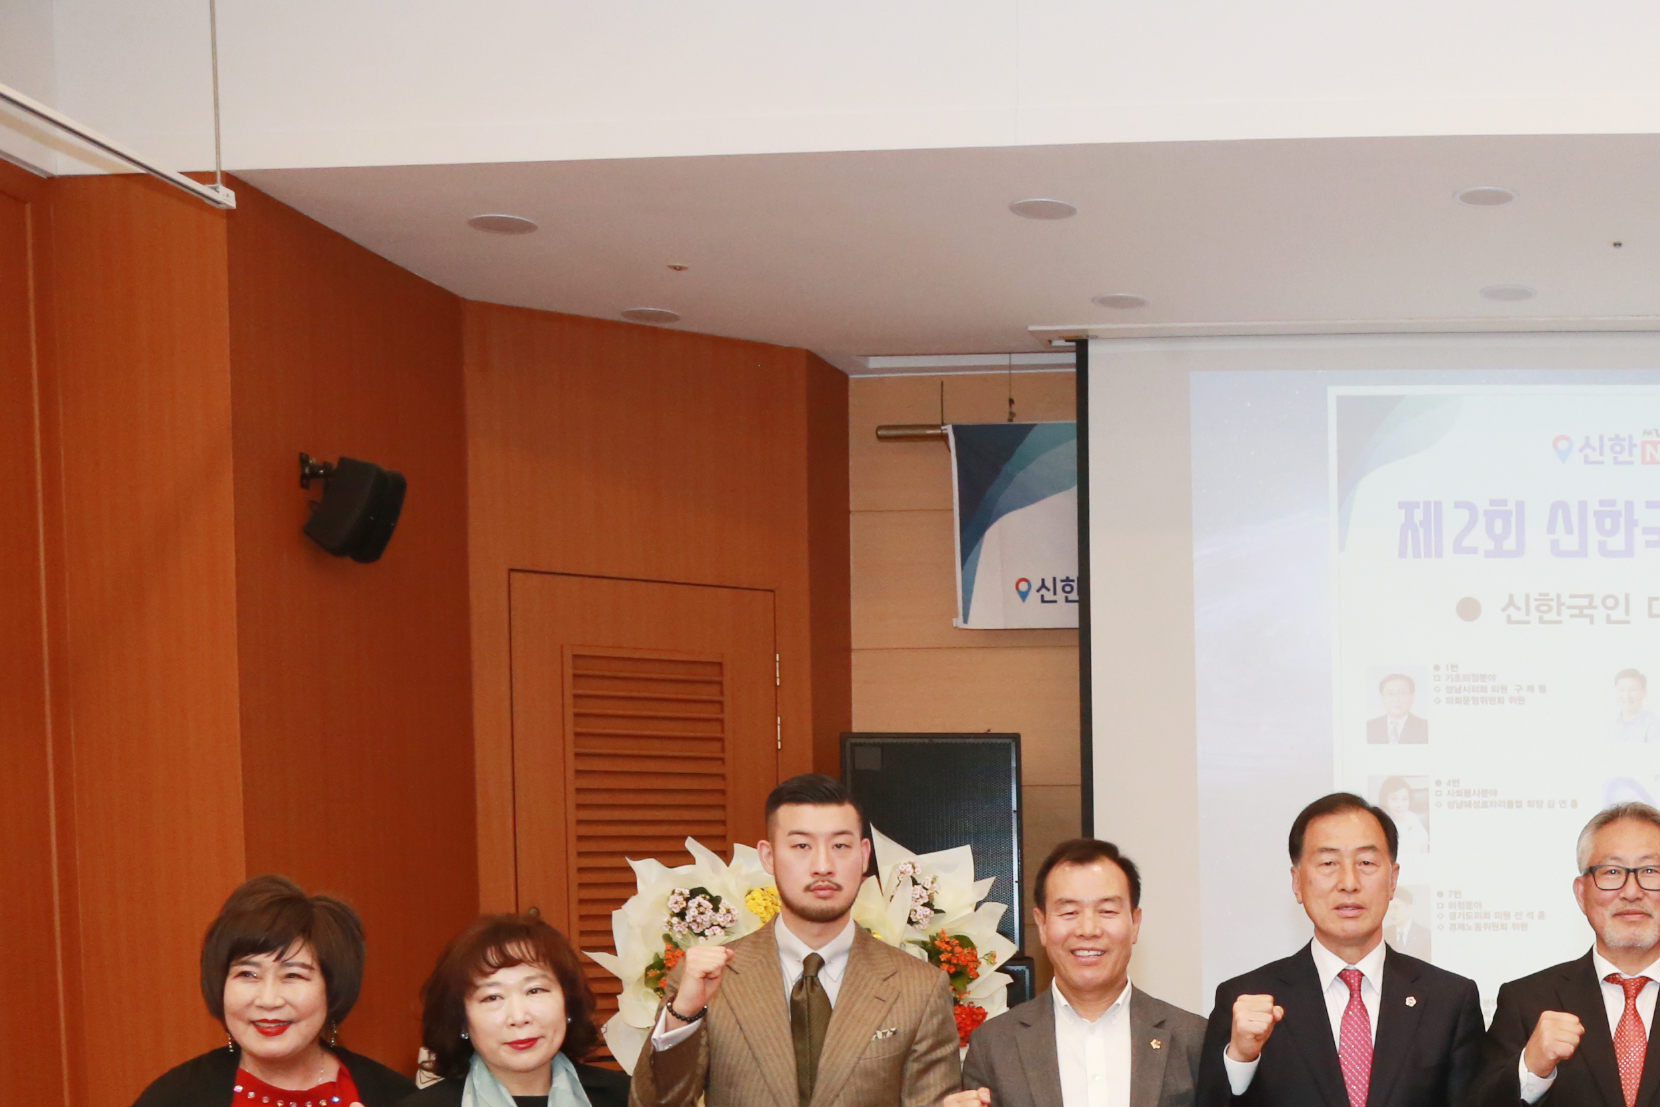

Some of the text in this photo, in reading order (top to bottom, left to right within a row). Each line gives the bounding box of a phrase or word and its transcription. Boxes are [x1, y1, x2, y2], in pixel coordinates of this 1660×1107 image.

[1578, 433, 1637, 465] 신한
[1398, 499, 1527, 560] 제2회
[1500, 592, 1631, 626] 신한국인
